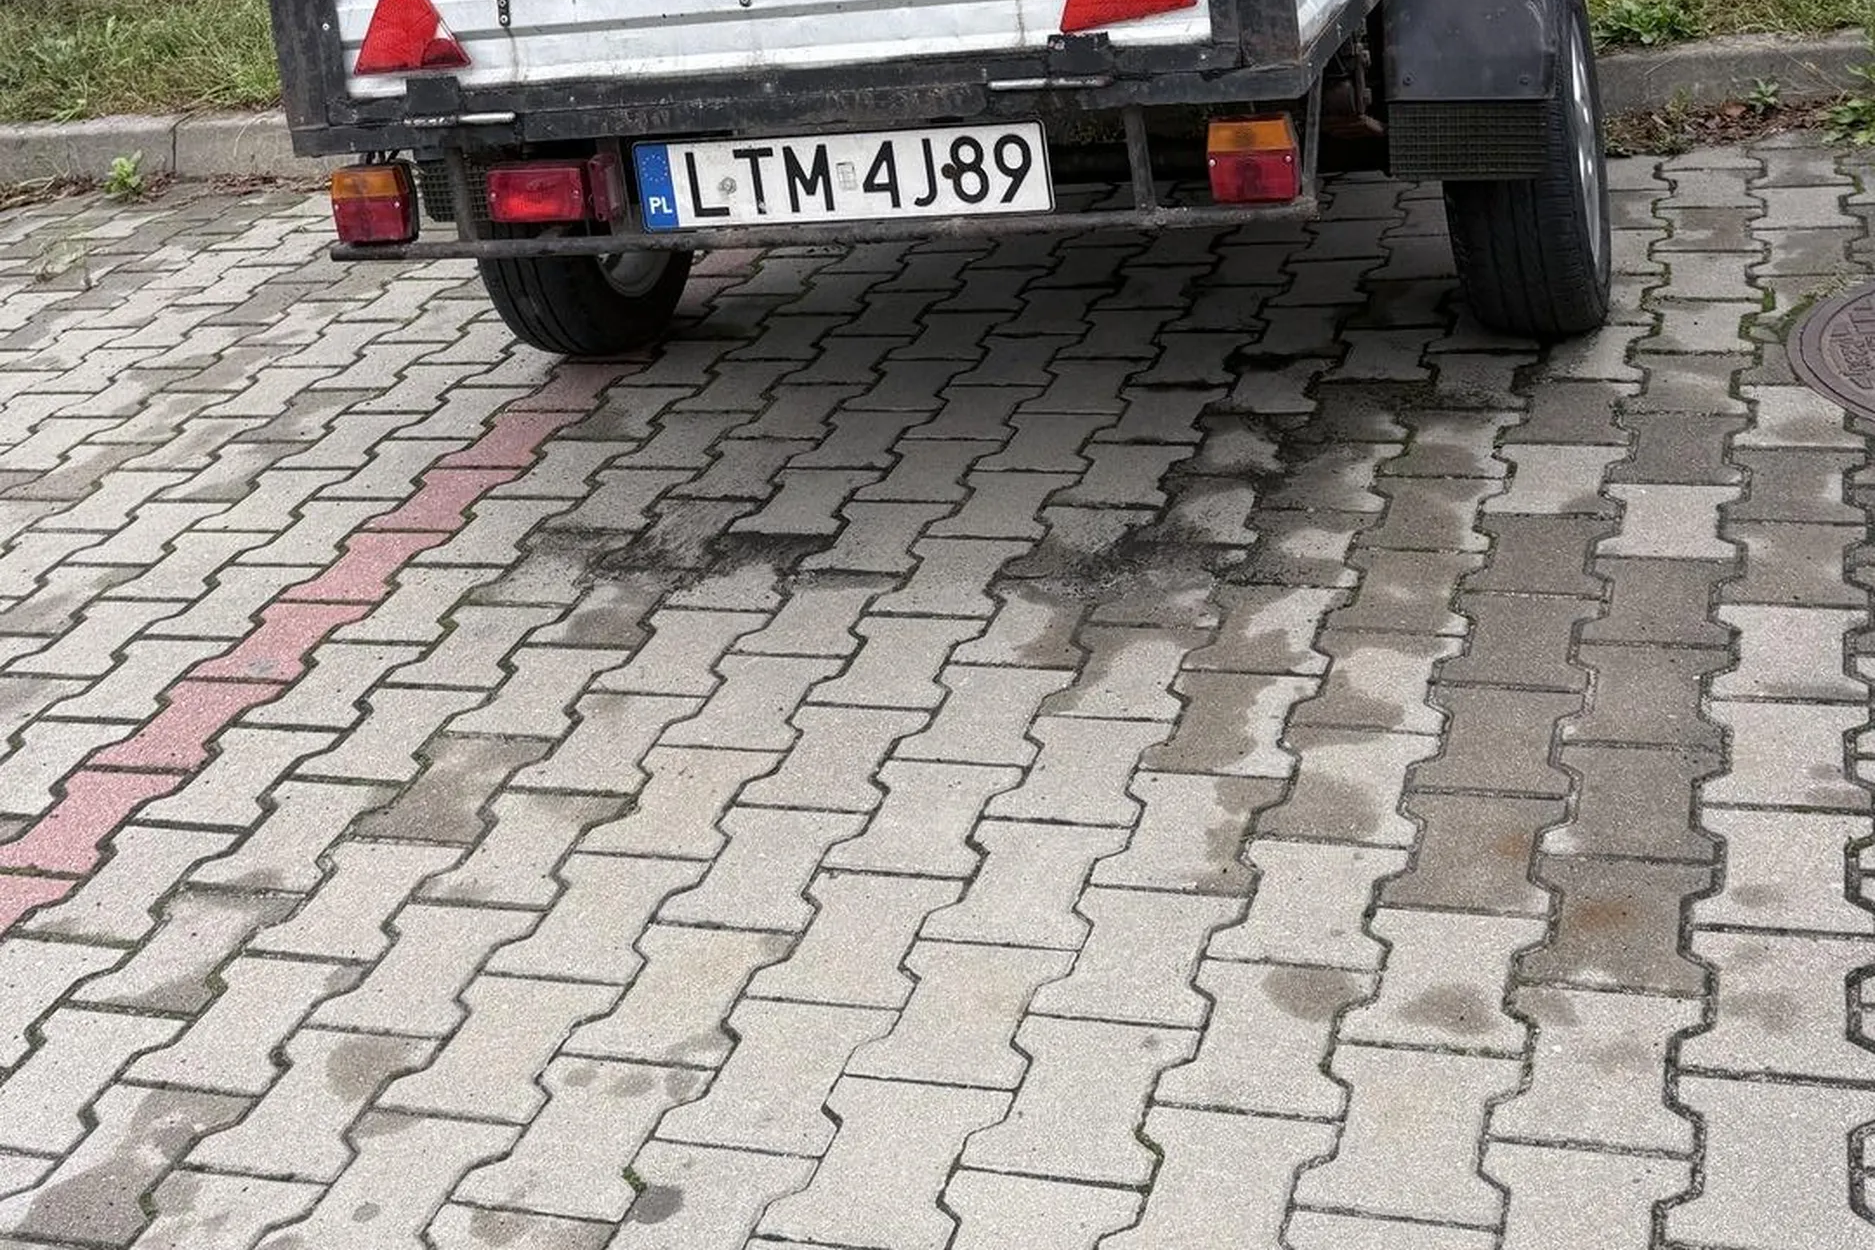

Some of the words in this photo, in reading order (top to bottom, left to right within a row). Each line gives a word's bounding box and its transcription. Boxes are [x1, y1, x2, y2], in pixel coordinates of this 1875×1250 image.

[684, 144, 835, 218] LTM
[862, 134, 1032, 209] 4J89
[649, 197, 673, 216] PL
